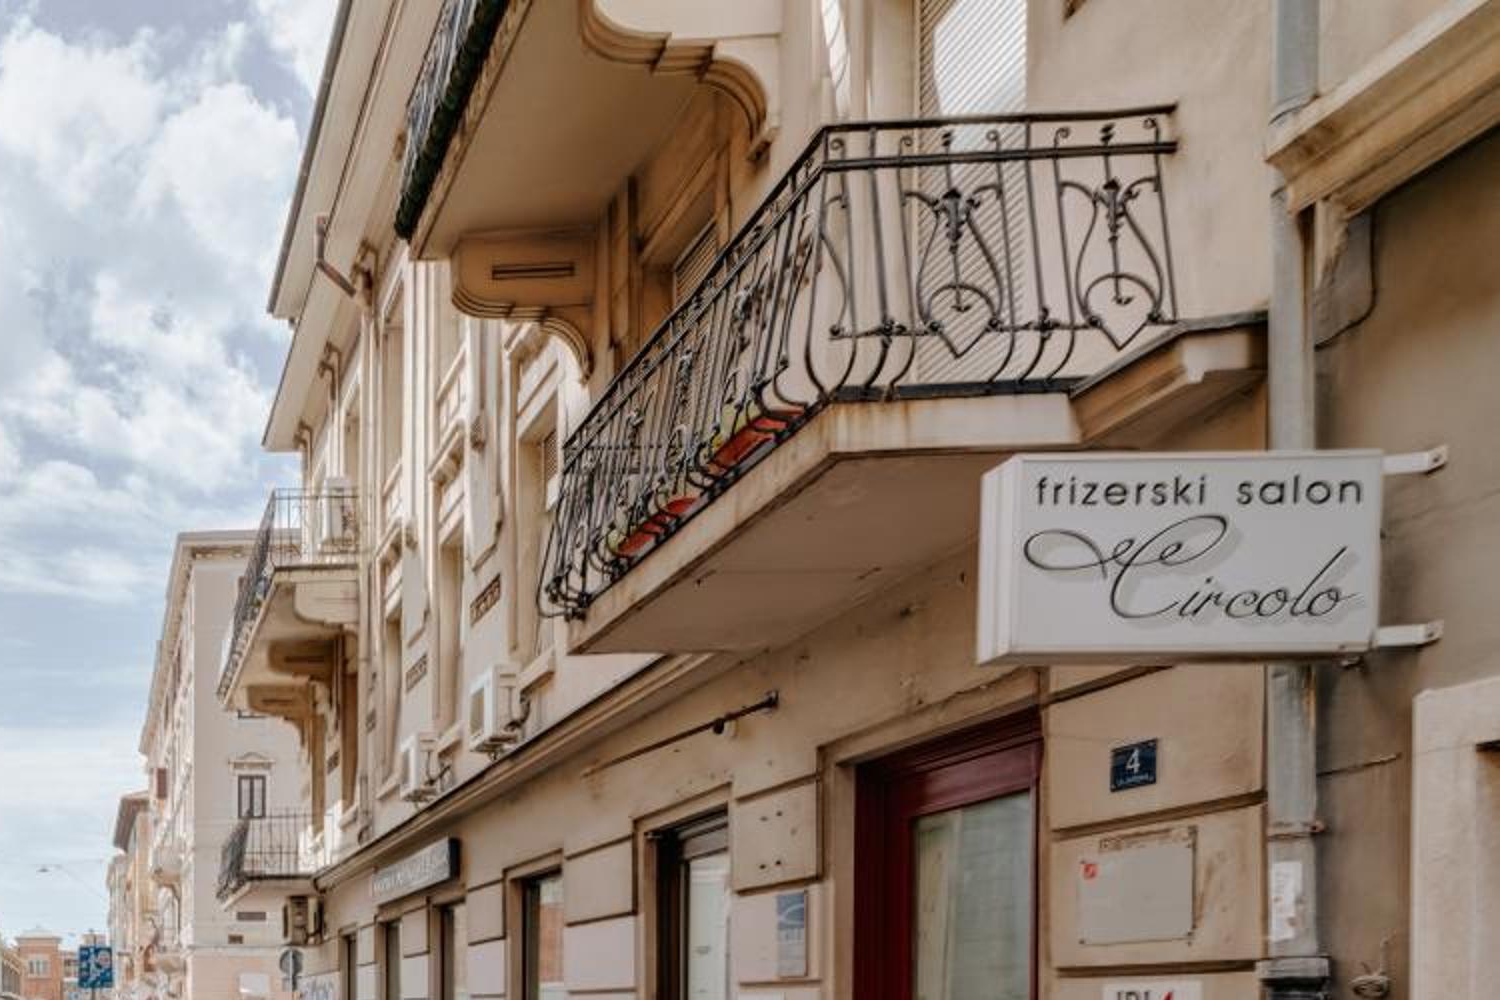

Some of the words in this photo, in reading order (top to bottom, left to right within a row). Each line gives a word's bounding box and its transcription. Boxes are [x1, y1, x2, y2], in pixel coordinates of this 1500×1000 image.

[1036, 474, 1207, 507] frizerski
[1237, 474, 1363, 506] salon
[1024, 514, 1355, 620] Circolo
[1125, 747, 1141, 774] 4
